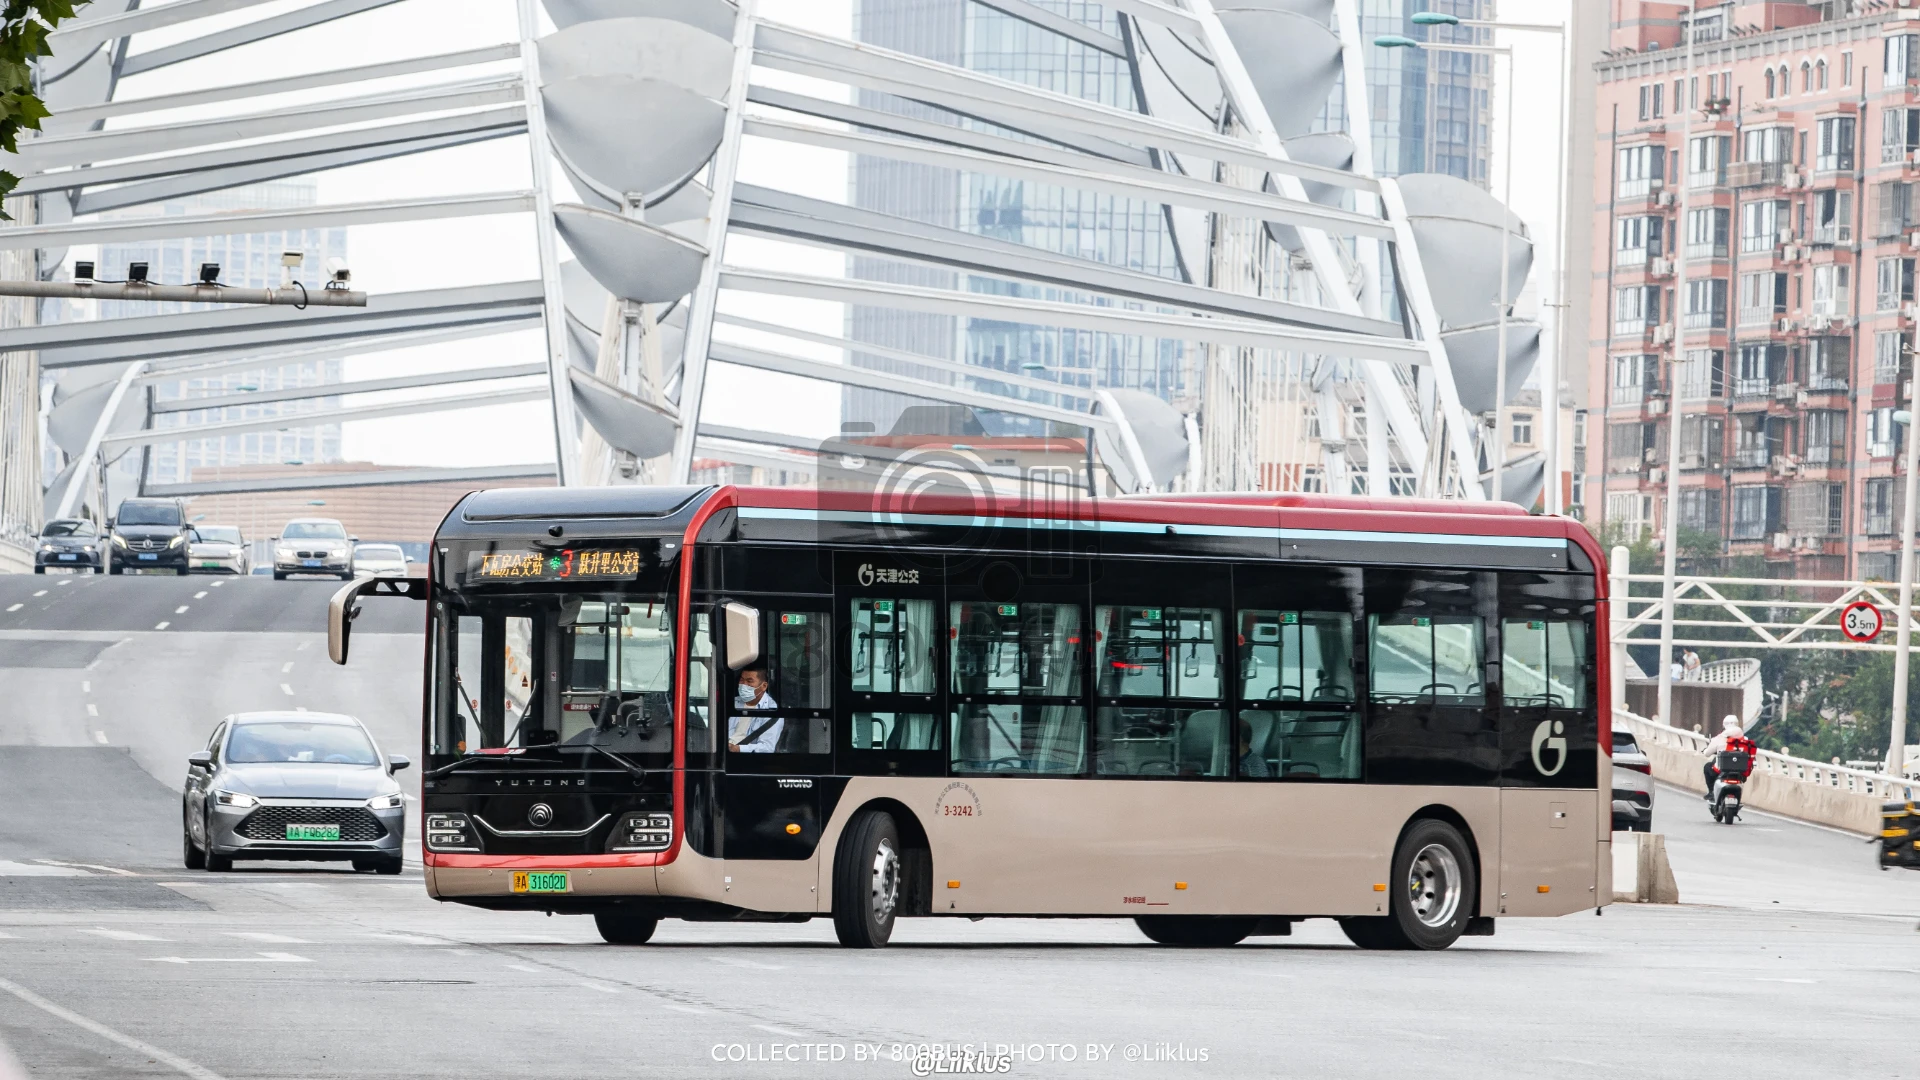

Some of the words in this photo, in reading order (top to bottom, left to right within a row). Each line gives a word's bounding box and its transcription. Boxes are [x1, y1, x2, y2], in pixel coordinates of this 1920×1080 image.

[481, 552, 545, 577] 下瓦房公交站
[559, 549, 574, 578] 3
[876, 568, 920, 584] 天津公交
[1847, 613, 1876, 630] 3.5m
[944, 805, 973, 817] 3-3242
